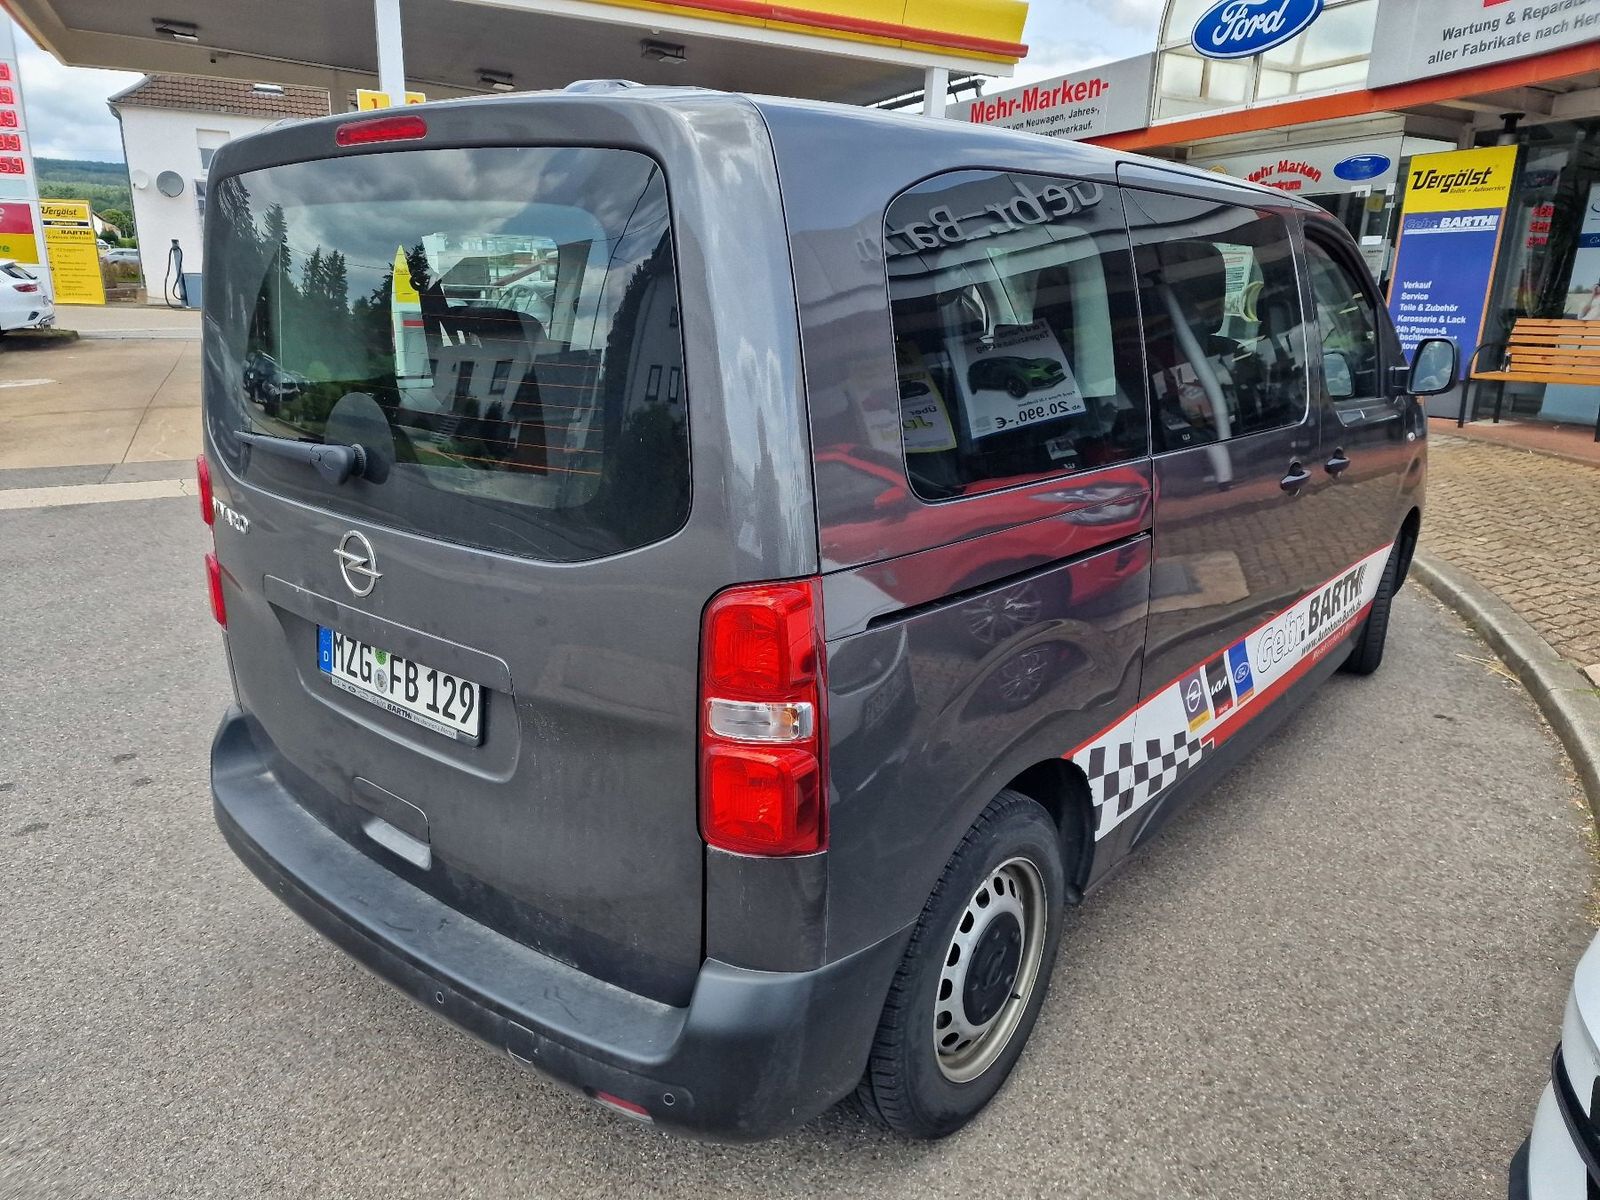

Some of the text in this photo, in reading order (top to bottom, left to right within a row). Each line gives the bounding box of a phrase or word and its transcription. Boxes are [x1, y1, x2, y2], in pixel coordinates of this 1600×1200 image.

[1212, 0, 1291, 46] Ford
[1442, 0, 1588, 41] Wartung & Reparat
[1427, 49, 1459, 65] aller
[1461, 32, 1531, 57] Fabrikate
[1535, 20, 1569, 40] nach
[970, 78, 1110, 124] Mehr-Marken-
[1025, 113, 1066, 128] Neuwagen,
[1068, 106, 1100, 119] Jahres-,
[1277, 160, 1322, 183] Marken
[1412, 167, 1493, 193] Vergölst
[41, 206, 78, 217] Vergölst
[1401, 292, 1429, 300] Service
[1403, 281, 1433, 289] Verkauf
[1399, 303, 1459, 312] Teile & Zubehör
[1397, 315, 1467, 324] Karosserie & Lack
[1257, 611, 1306, 674] Gebr.
[1308, 563, 1368, 637] BARTH
[323, 650, 330, 662] D
[333, 630, 475, 724] MZG FB 129
